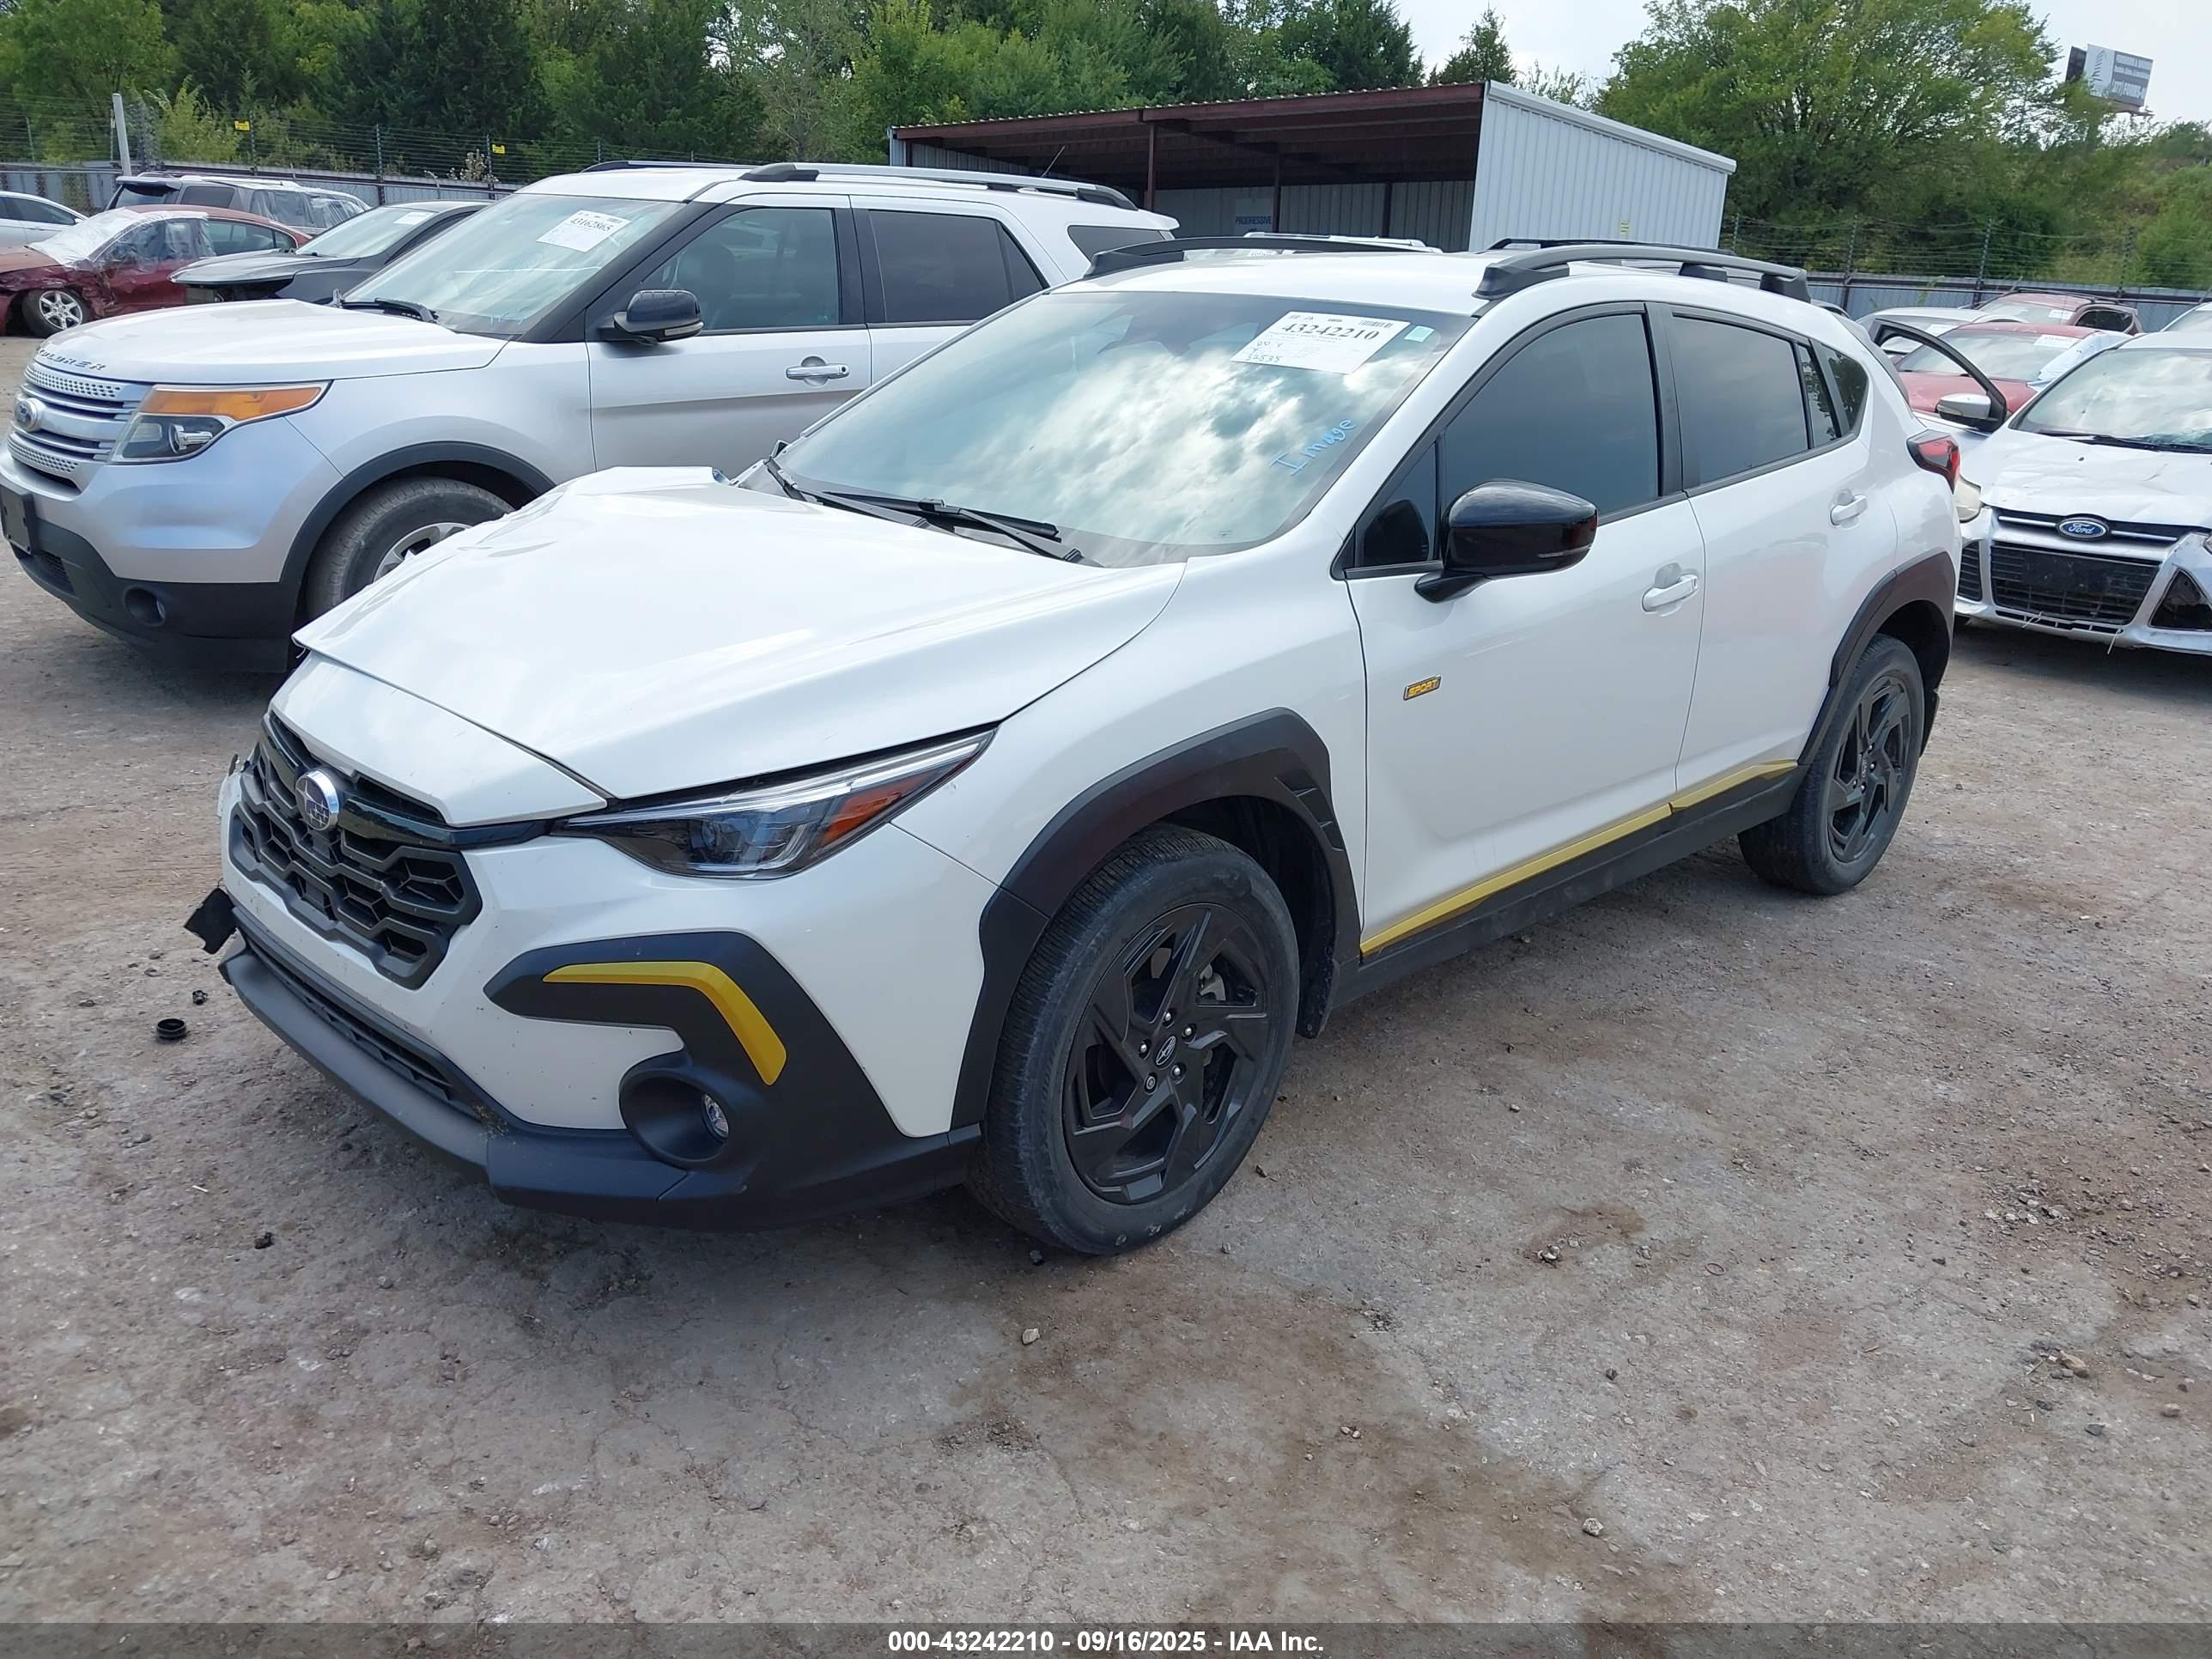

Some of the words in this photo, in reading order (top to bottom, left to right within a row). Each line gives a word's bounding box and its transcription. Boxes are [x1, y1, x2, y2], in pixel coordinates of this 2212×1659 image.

[1282, 324, 1379, 339] 43242210
[1270, 419, 1356, 476] Image
[2068, 523, 2095, 533] Ford
[1408, 679, 1437, 696] SPORT
